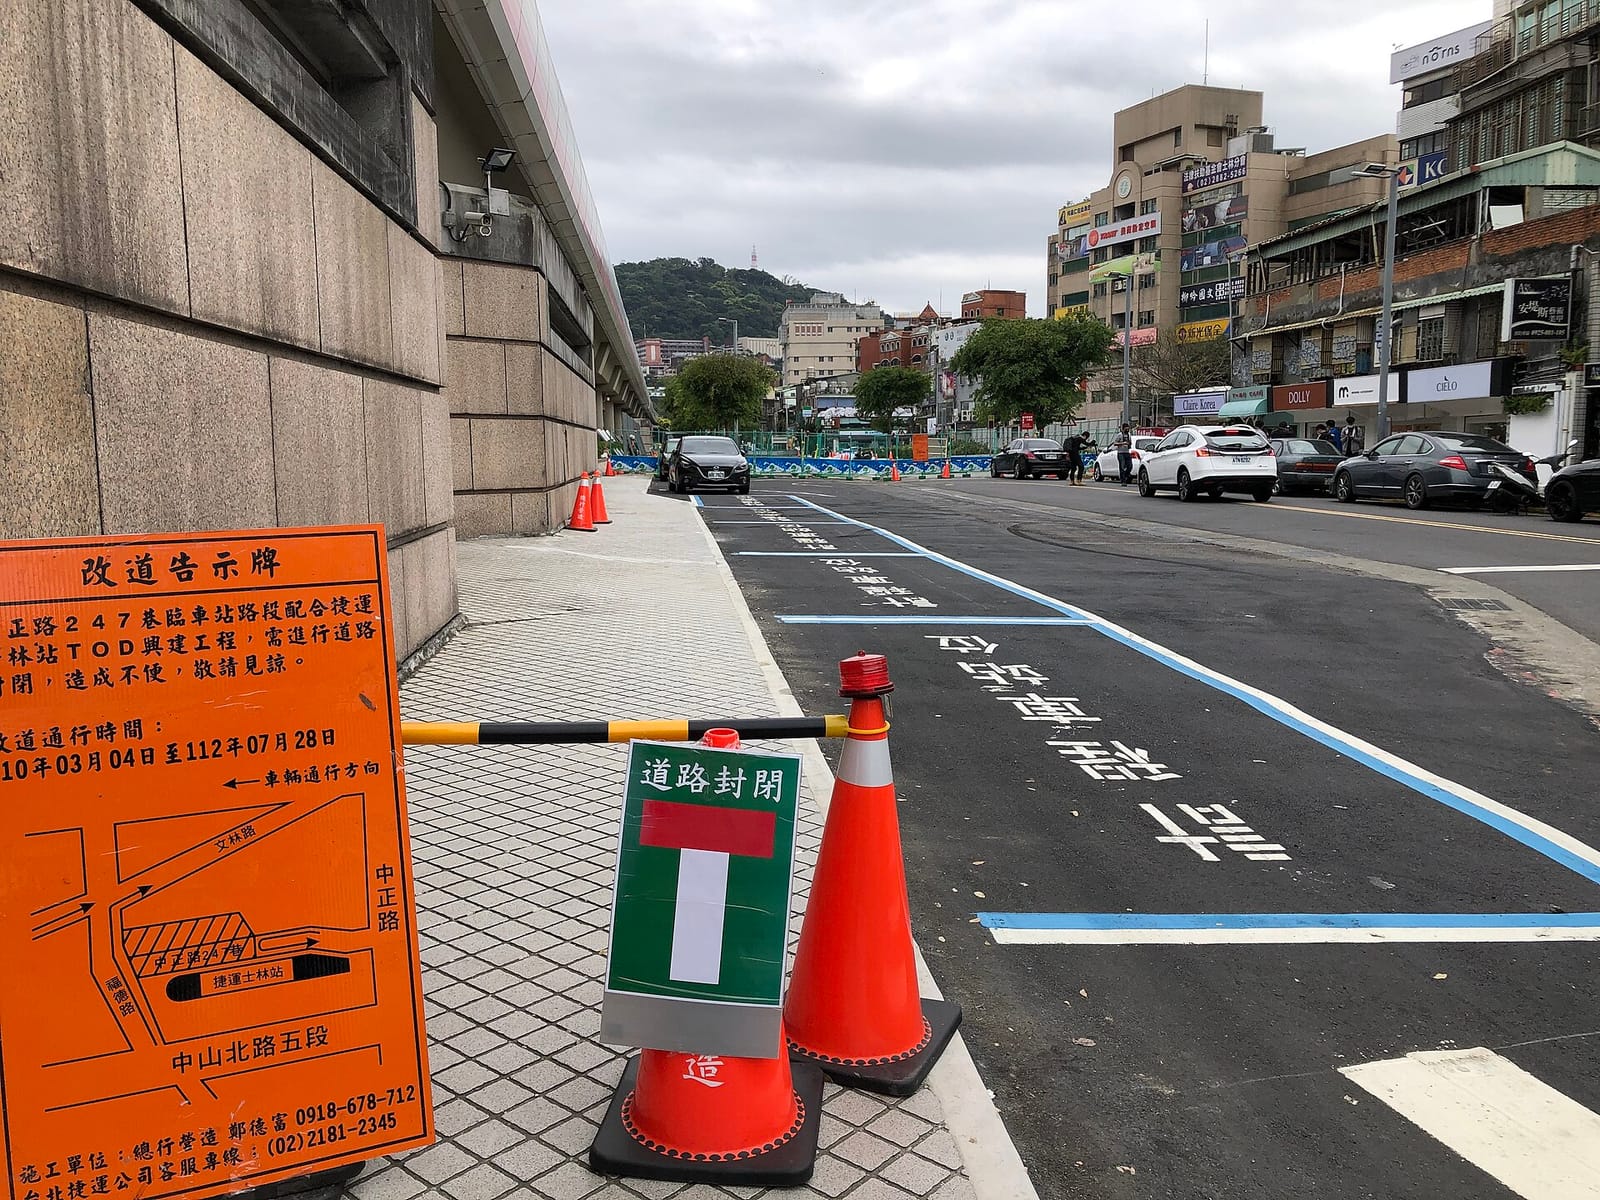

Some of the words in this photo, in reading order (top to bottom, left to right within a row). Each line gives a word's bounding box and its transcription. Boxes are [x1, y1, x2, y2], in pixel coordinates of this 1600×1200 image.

[1183, 399, 1199, 411] Claire
[1200, 398, 1216, 410] Korea
[1288, 390, 1311, 403] DOLLY
[1436, 380, 1458, 392] CIELO
[81, 547, 281, 588] 改道告示牌
[0, 620, 377, 667] 林站TOD興建工程，需進行道路
[264, 760, 380, 788] 車輛通行方向
[640, 757, 784, 804] 道路封閉
[214, 824, 257, 853] 文林路
[376, 863, 400, 932] 中正路
[213, 965, 284, 989] 捷運士林站
[105, 976, 136, 1017] 福德路
[171, 1025, 329, 1075] 中山北路五段
[682, 1055, 725, 1088] 造
[295, 1084, 416, 1127] 0918-678-712
